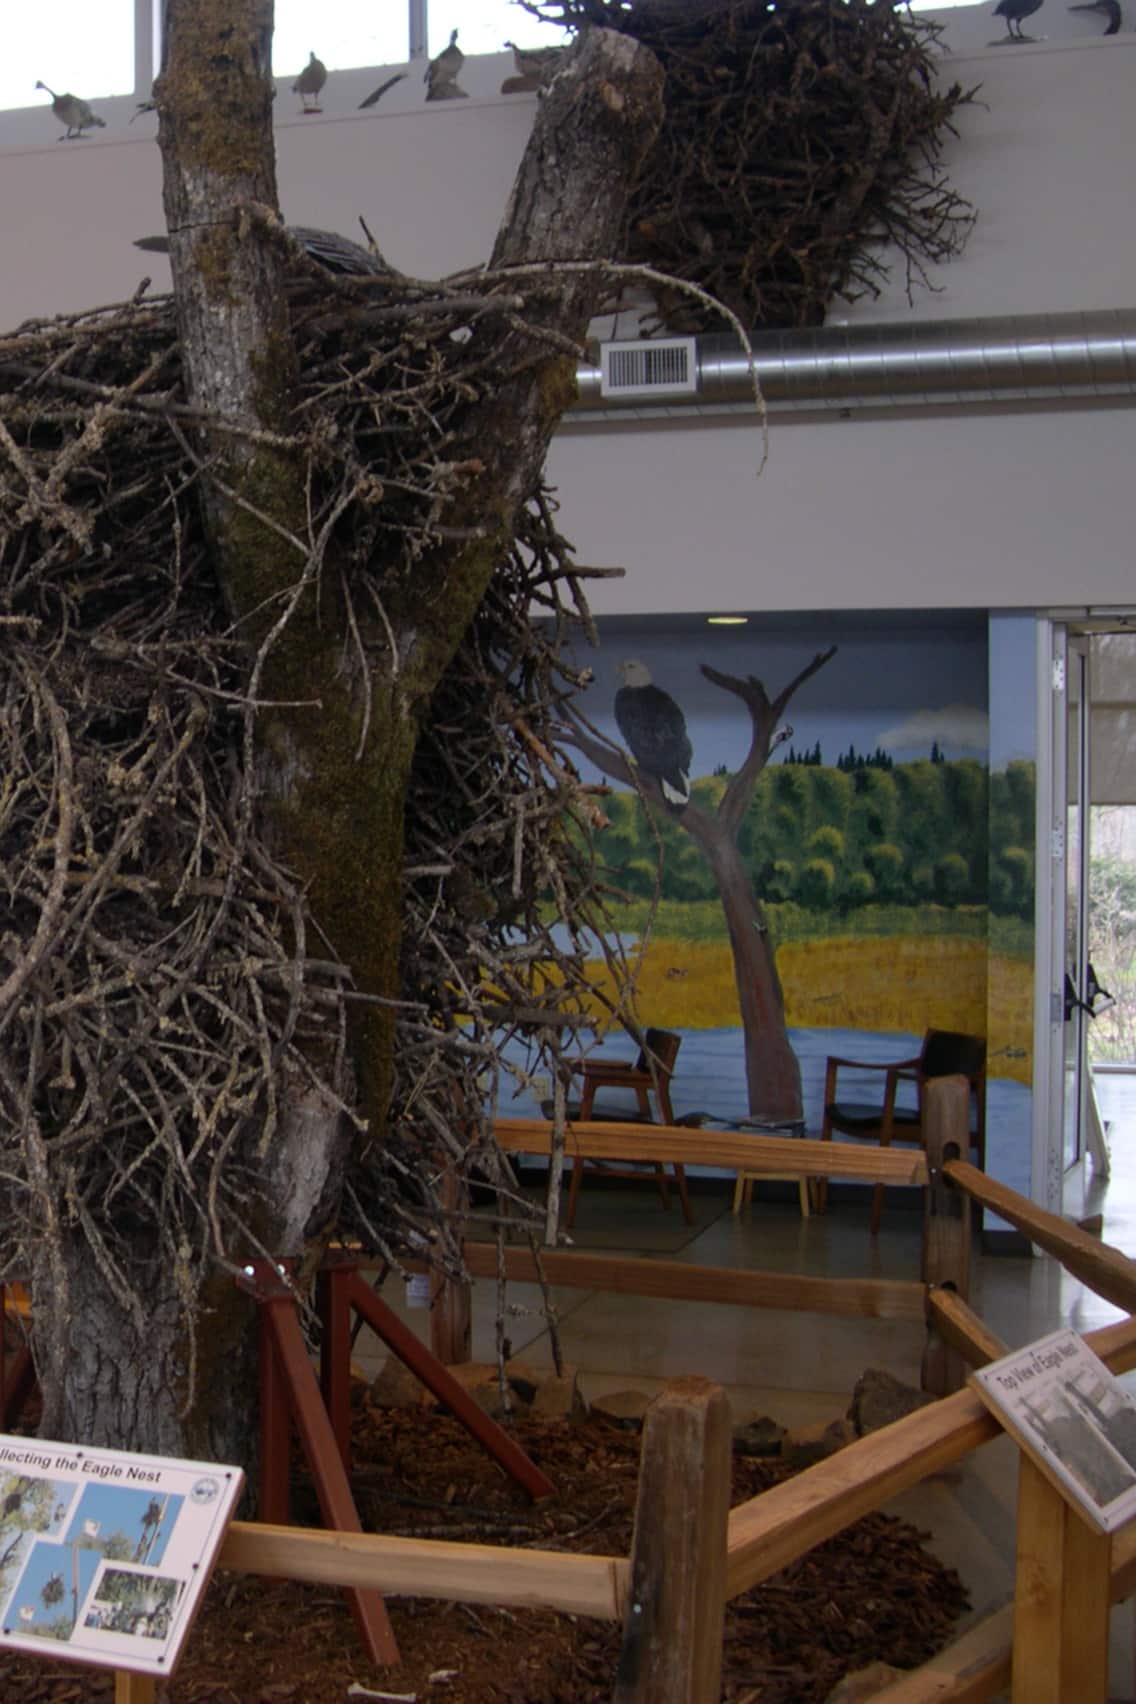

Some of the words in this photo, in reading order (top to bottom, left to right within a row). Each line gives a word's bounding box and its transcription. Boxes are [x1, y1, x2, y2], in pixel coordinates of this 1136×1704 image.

[996, 1375, 1019, 1391] Top
[1009, 1367, 1035, 1383] View
[1037, 1352, 1065, 1369] Eagle
[55, 1457, 78, 1471] the
[81, 1460, 123, 1478] Eagle
[126, 1467, 161, 1483] Nest
